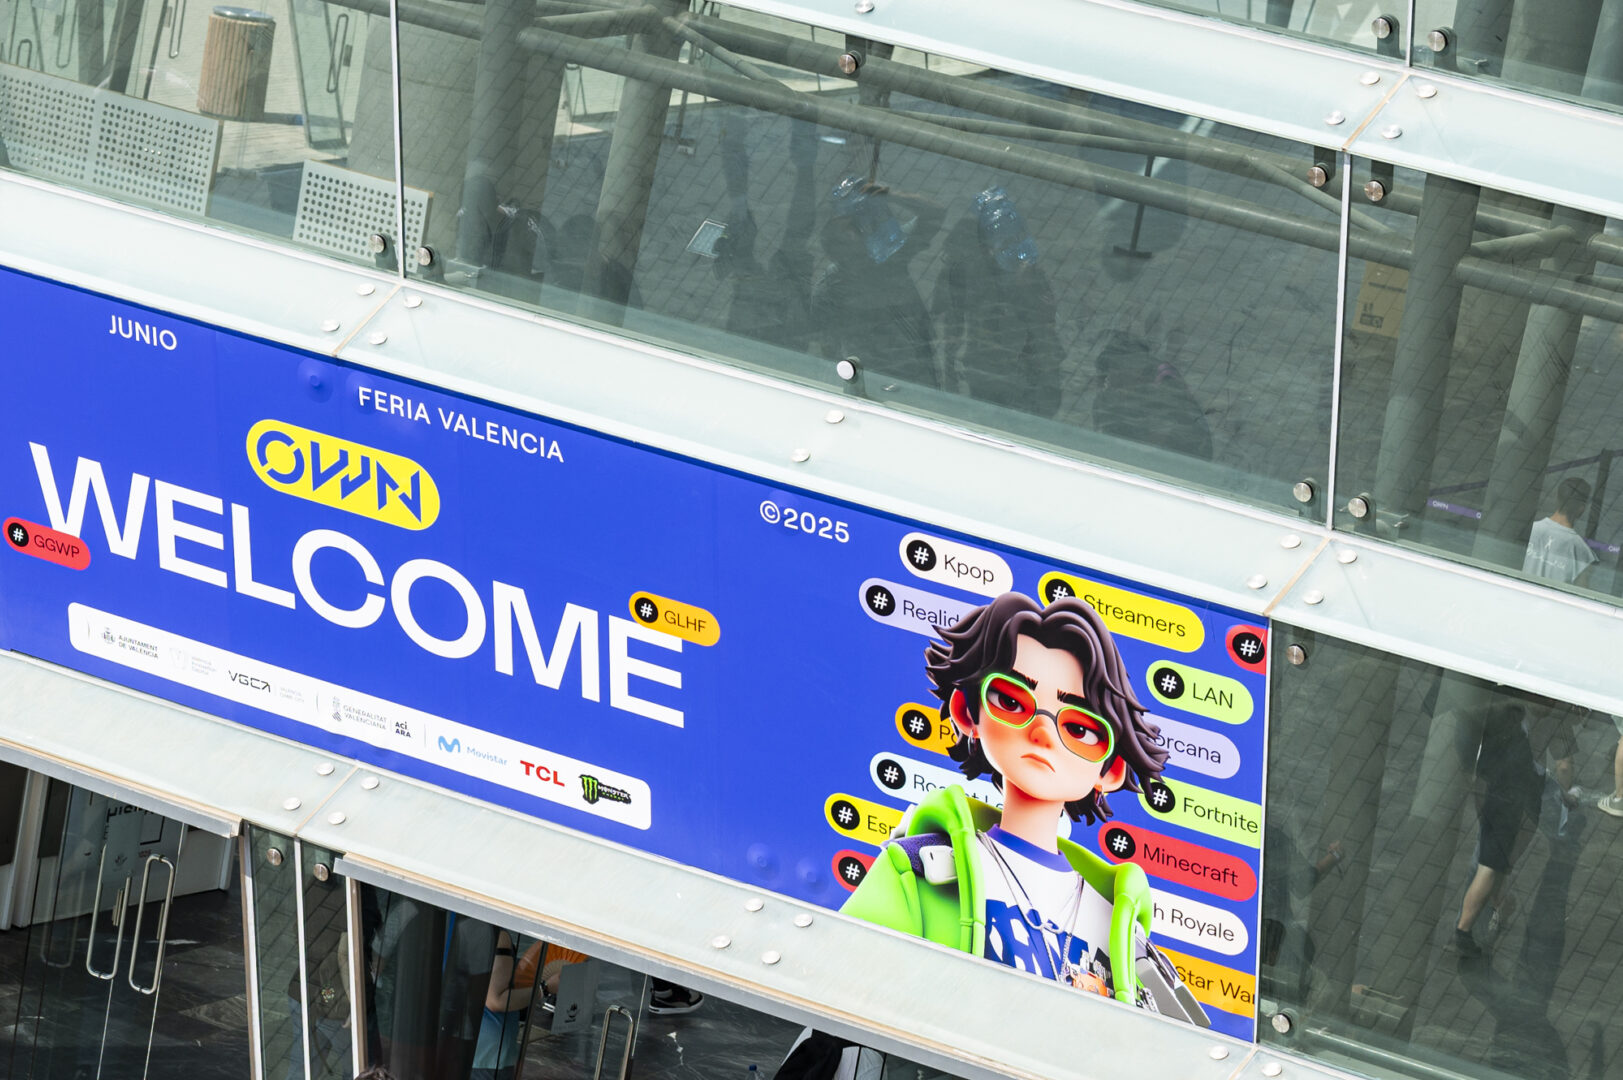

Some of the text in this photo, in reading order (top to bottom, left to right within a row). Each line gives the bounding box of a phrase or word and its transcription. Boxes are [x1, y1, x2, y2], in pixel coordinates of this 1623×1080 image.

[108, 314, 177, 351] JUNIO
[357, 386, 565, 463] FERIA VALENCIA
[255, 430, 422, 524] OWN
[33, 532, 81, 561] GGWP
[943, 553, 995, 585] Kpop
[28, 441, 685, 729] WELCOME
[663, 608, 707, 633] GLHF
[902, 599, 960, 628] Realid
[1083, 594, 1186, 638] Streamers
[1192, 682, 1234, 710] LAN
[343, 704, 387, 723] GENERALITAT
[344, 712, 387, 730] VALENCIANA
[395, 728, 411, 738] ARA
[466, 745, 509, 766] Movistar
[1153, 733, 1222, 764] orcana
[519, 759, 566, 787] TCL
[1183, 797, 1259, 834] Fortnite
[1143, 843, 1239, 888] Minecraft
[1171, 908, 1235, 943] Royale
[1175, 965, 1214, 991] Star
